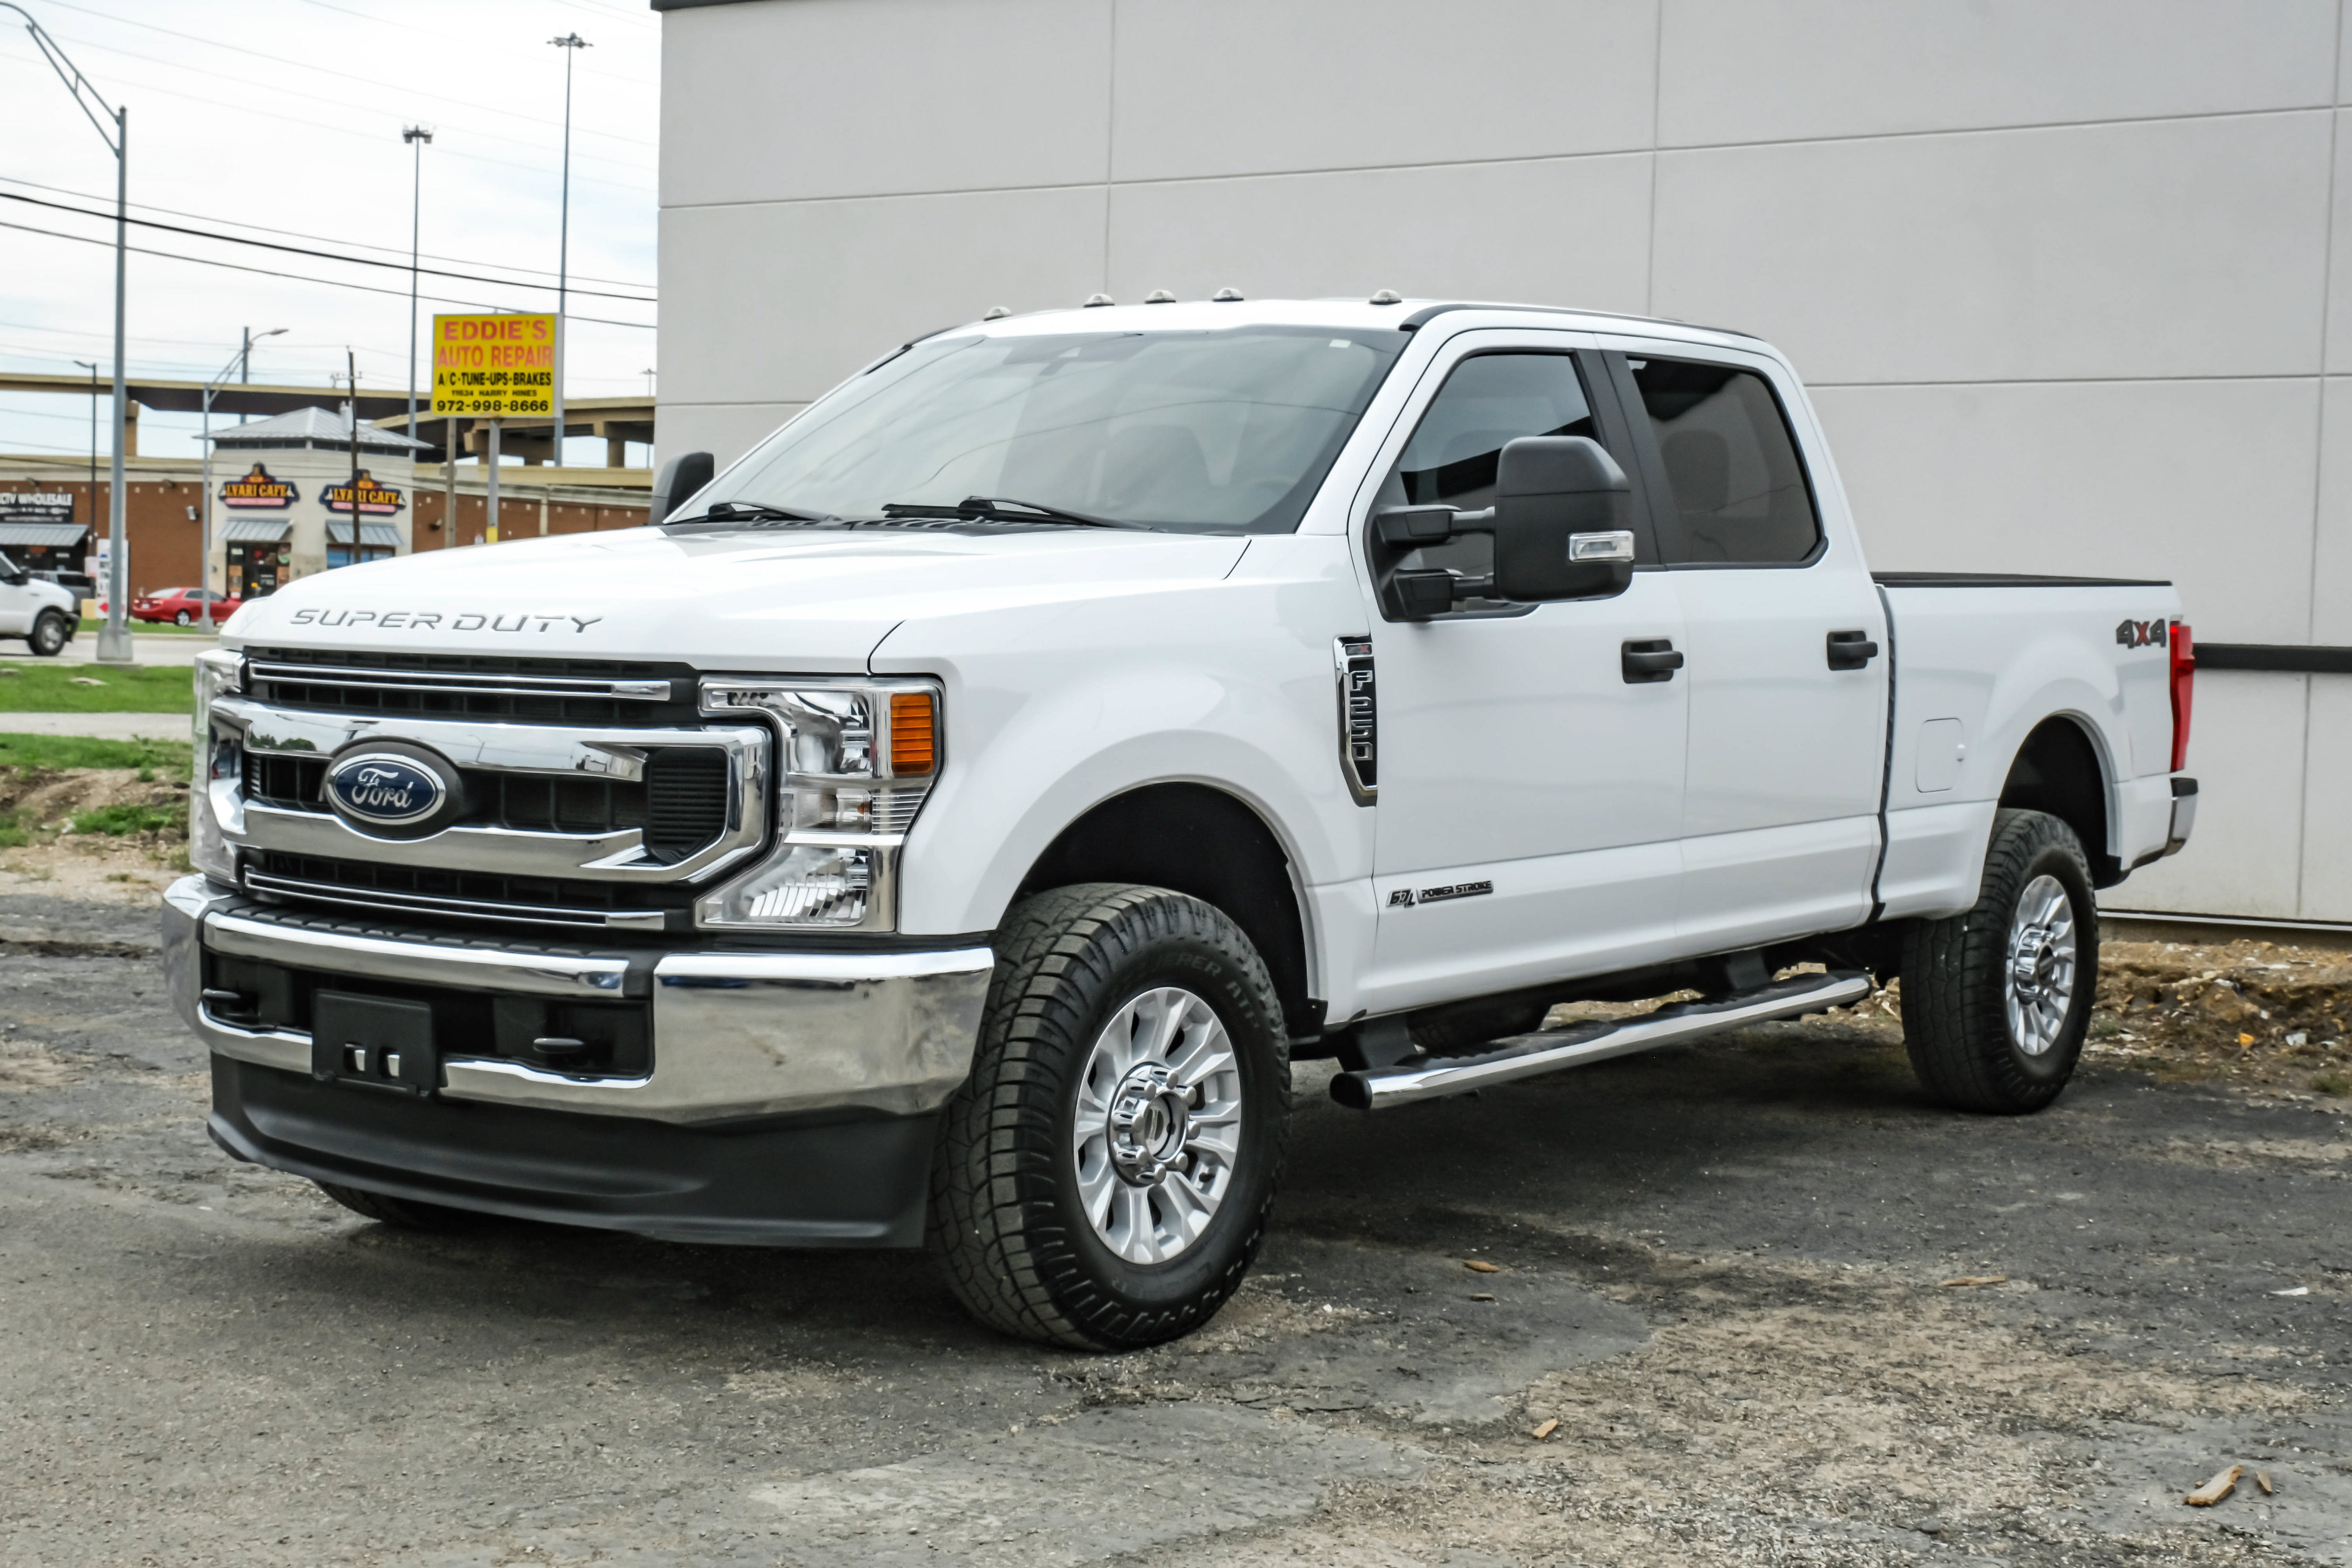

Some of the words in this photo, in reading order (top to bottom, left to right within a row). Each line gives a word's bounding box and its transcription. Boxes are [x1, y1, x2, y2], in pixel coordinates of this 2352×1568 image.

[444, 320, 548, 340] EDDIE'S
[437, 345, 483, 368] AUTO
[491, 345, 553, 368] REPAIR
[437, 400, 548, 411] 972-998-8666
[227, 484, 257, 497] LYARI
[290, 608, 443, 630] SUPER
[452, 613, 604, 634] DUTY
[351, 767, 414, 808] Ford
[1421, 885, 1454, 898] POWER
[1456, 880, 1492, 893] STROKE
